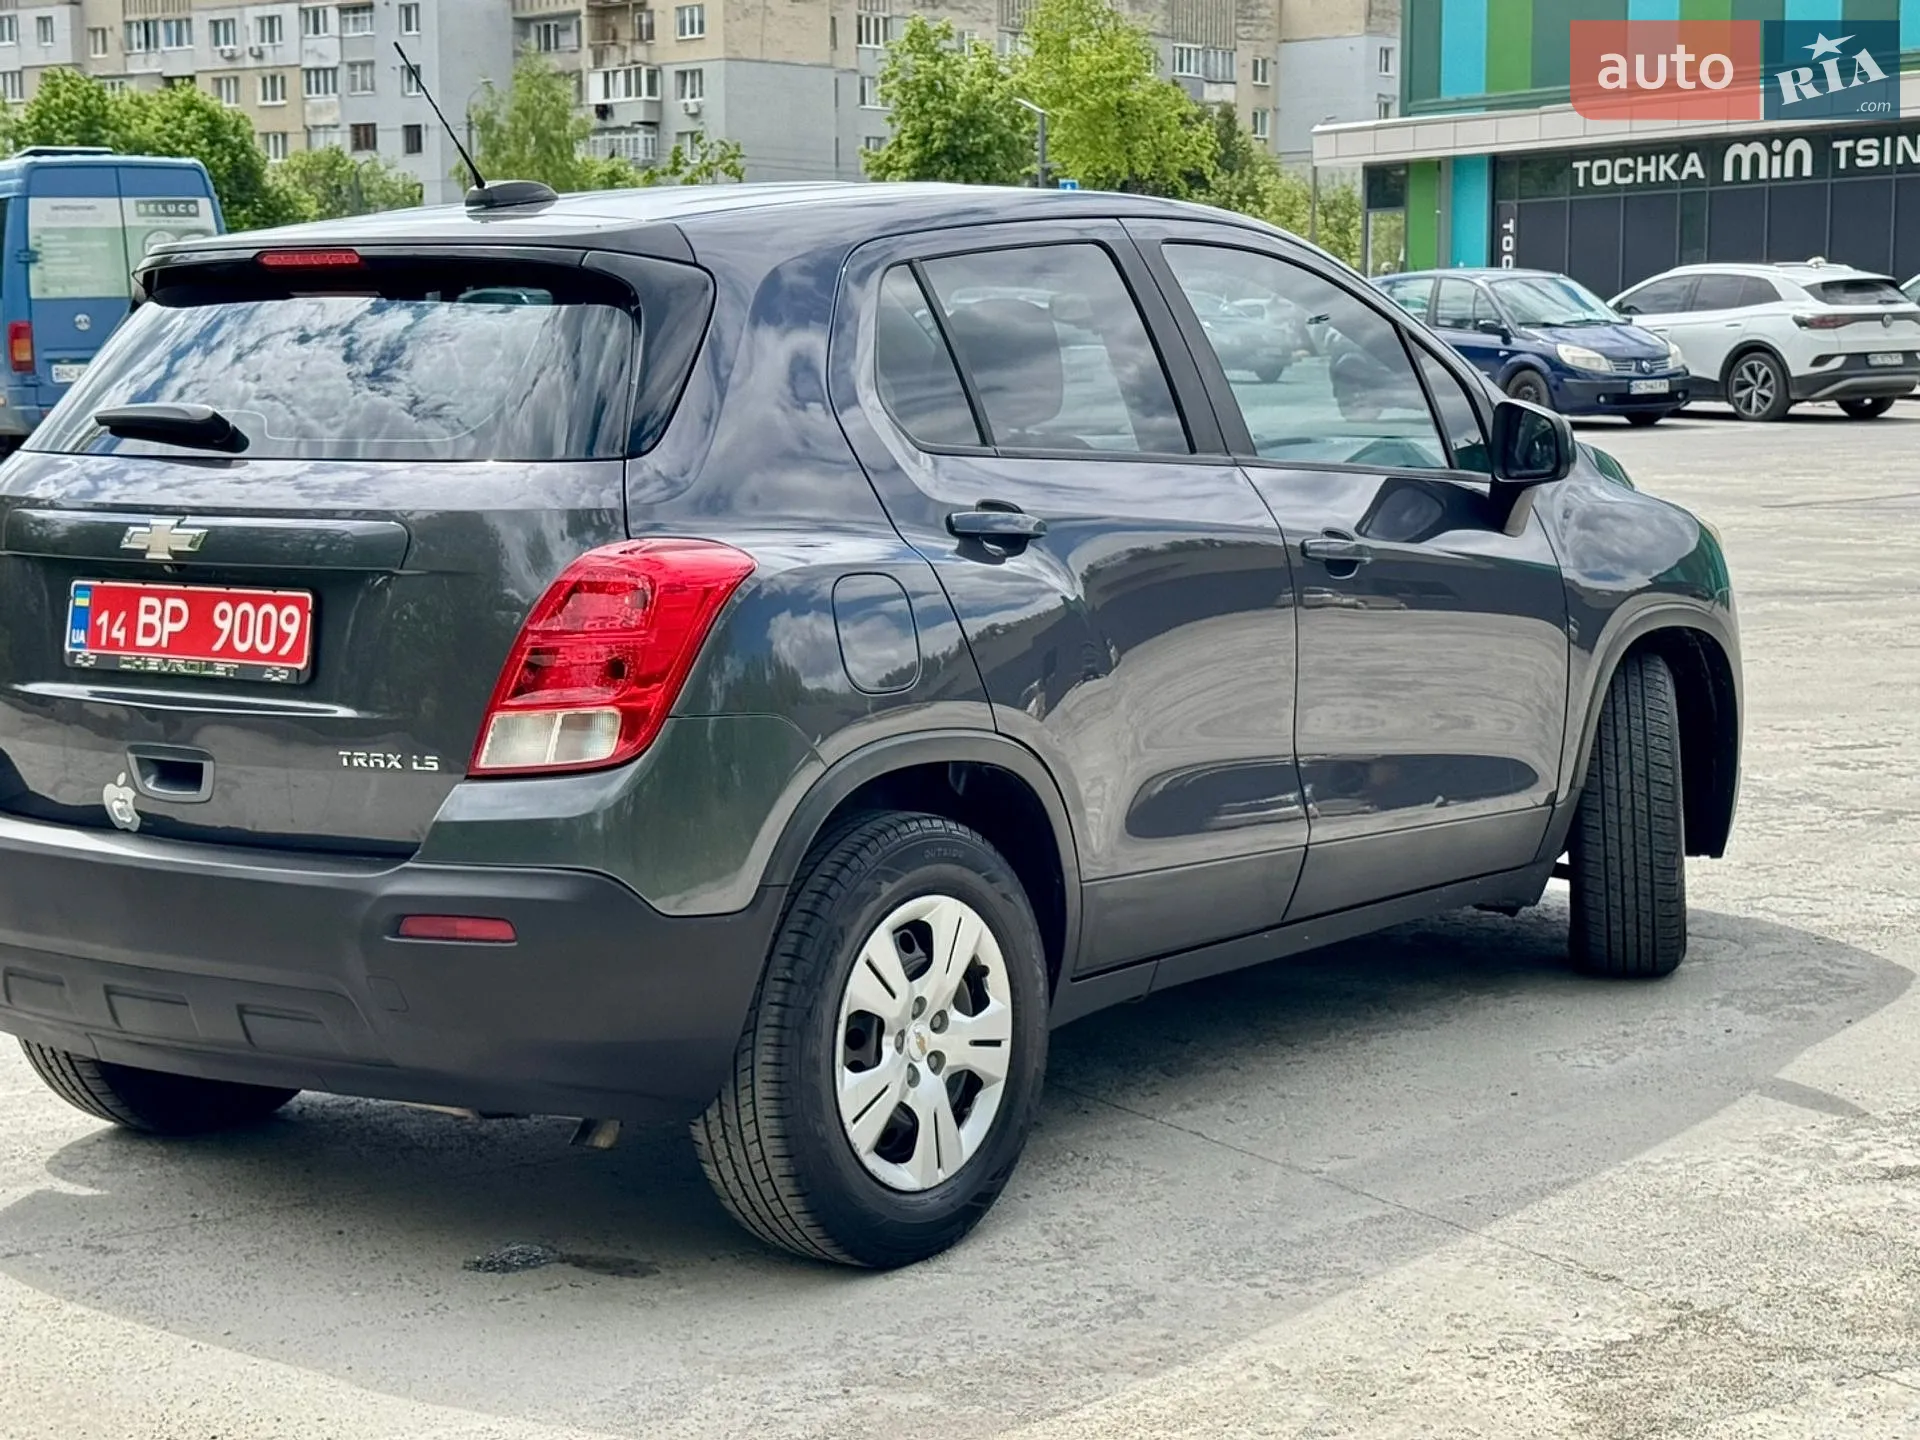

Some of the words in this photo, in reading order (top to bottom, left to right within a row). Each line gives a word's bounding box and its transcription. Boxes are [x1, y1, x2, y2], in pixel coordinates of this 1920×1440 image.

[1572, 152, 1705, 187] TOCHKA
[1832, 134, 1920, 169] TSIN
[138, 203, 197, 214] BELUCO
[71, 629, 86, 644] UA
[96, 609, 127, 648] 14
[211, 601, 301, 656] 9009
[119, 655, 239, 677] CHEVROLET
[338, 751, 402, 769] TRAX
[412, 755, 439, 771] LS
